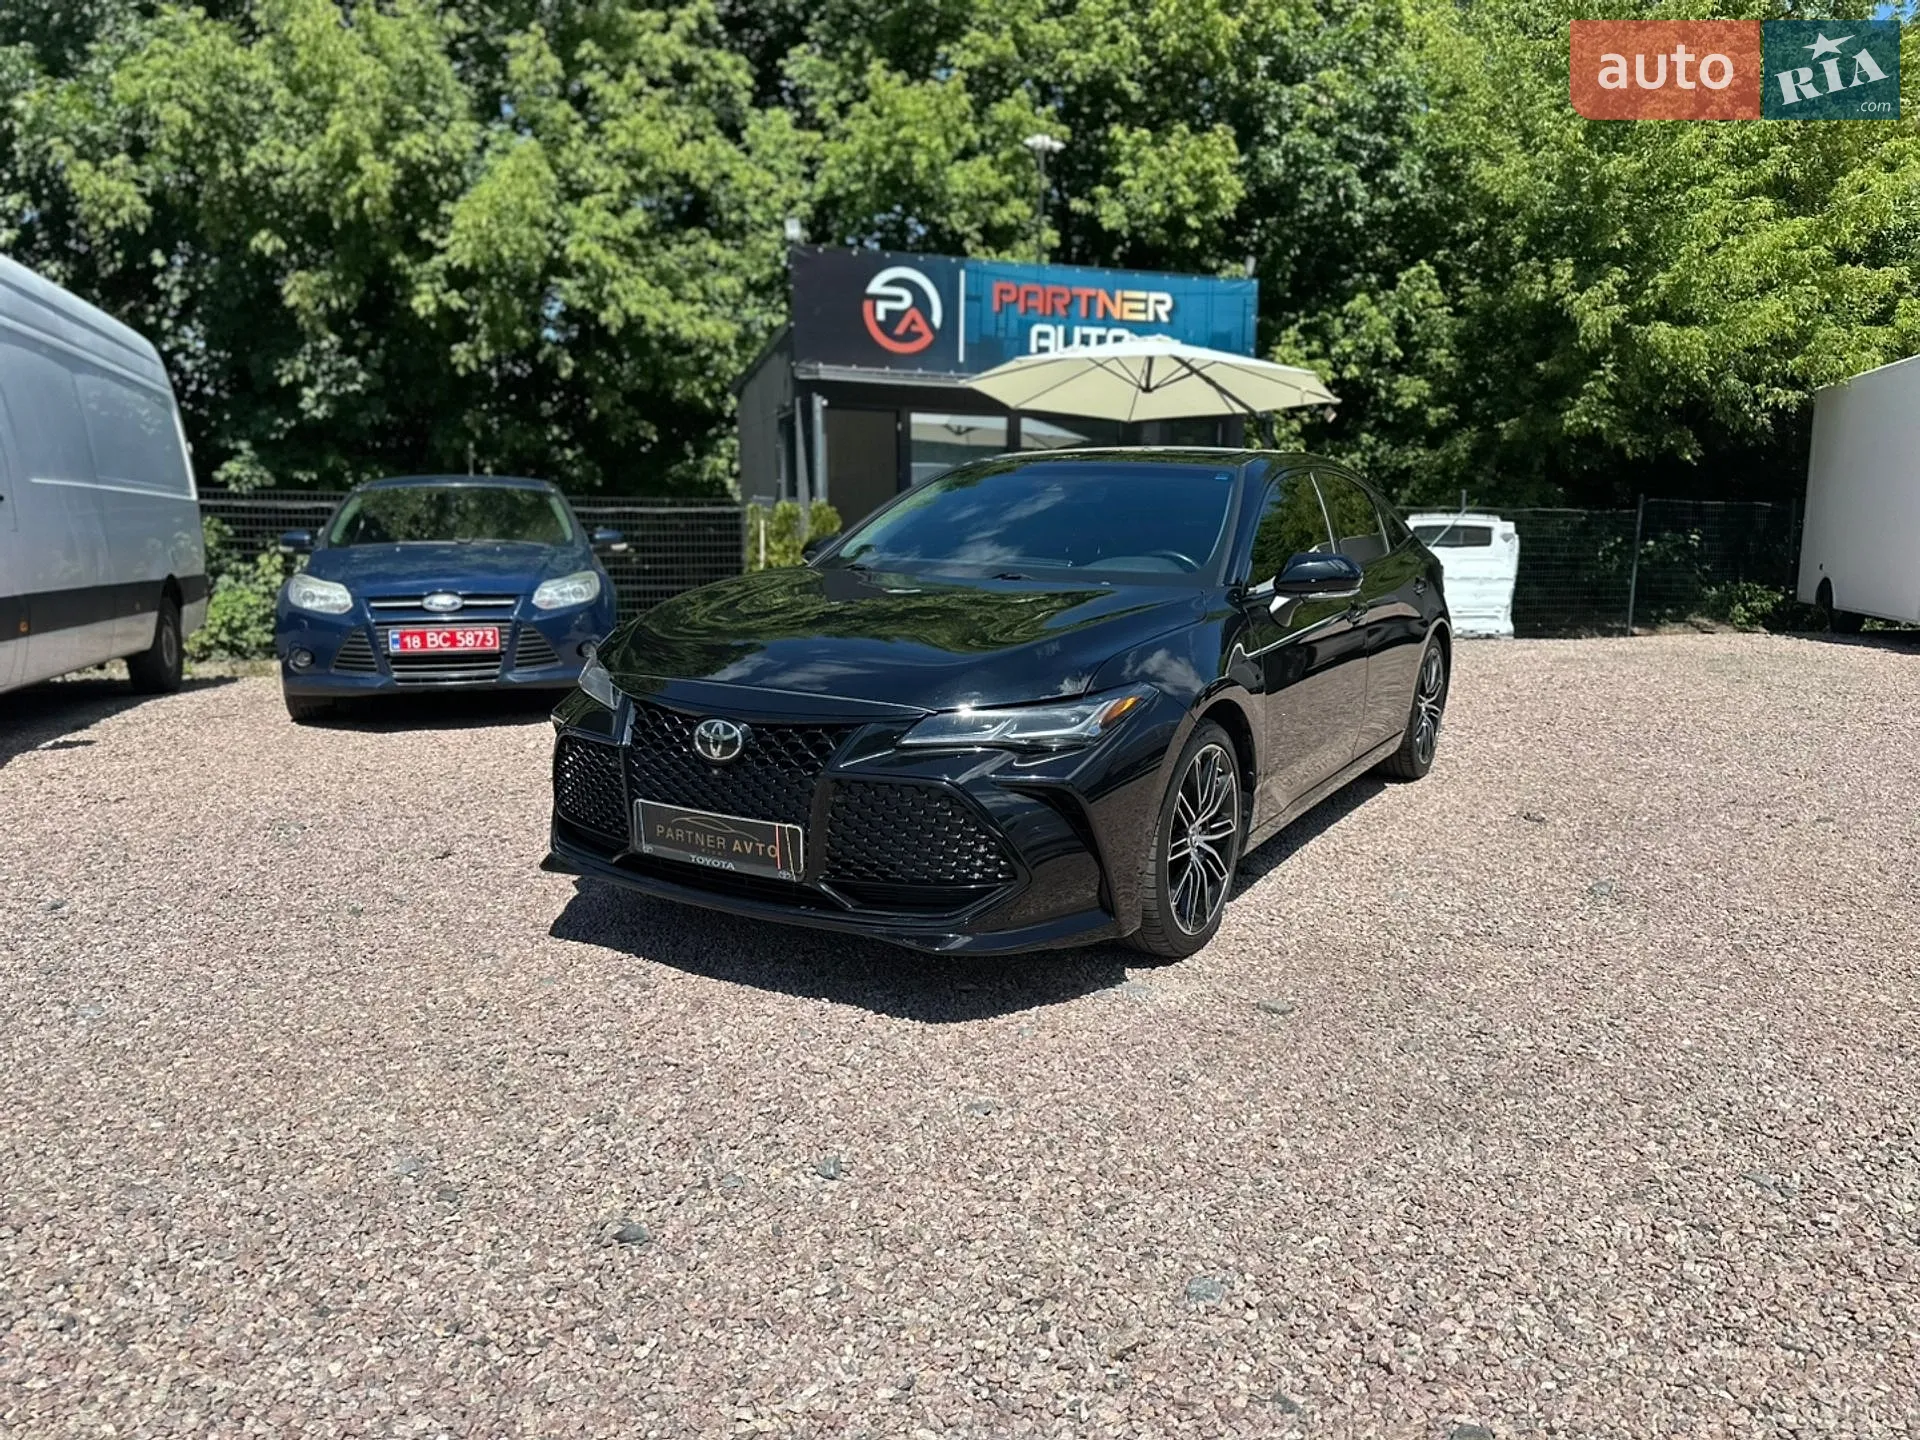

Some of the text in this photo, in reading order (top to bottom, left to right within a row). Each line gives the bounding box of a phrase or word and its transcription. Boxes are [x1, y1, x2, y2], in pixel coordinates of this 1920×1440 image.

[992, 281, 1173, 322] PARTNER
[403, 630, 494, 649] 18 BC 5873
[655, 824, 778, 859] PARTNER AVTO
[689, 854, 735, 871] TOYOTA
